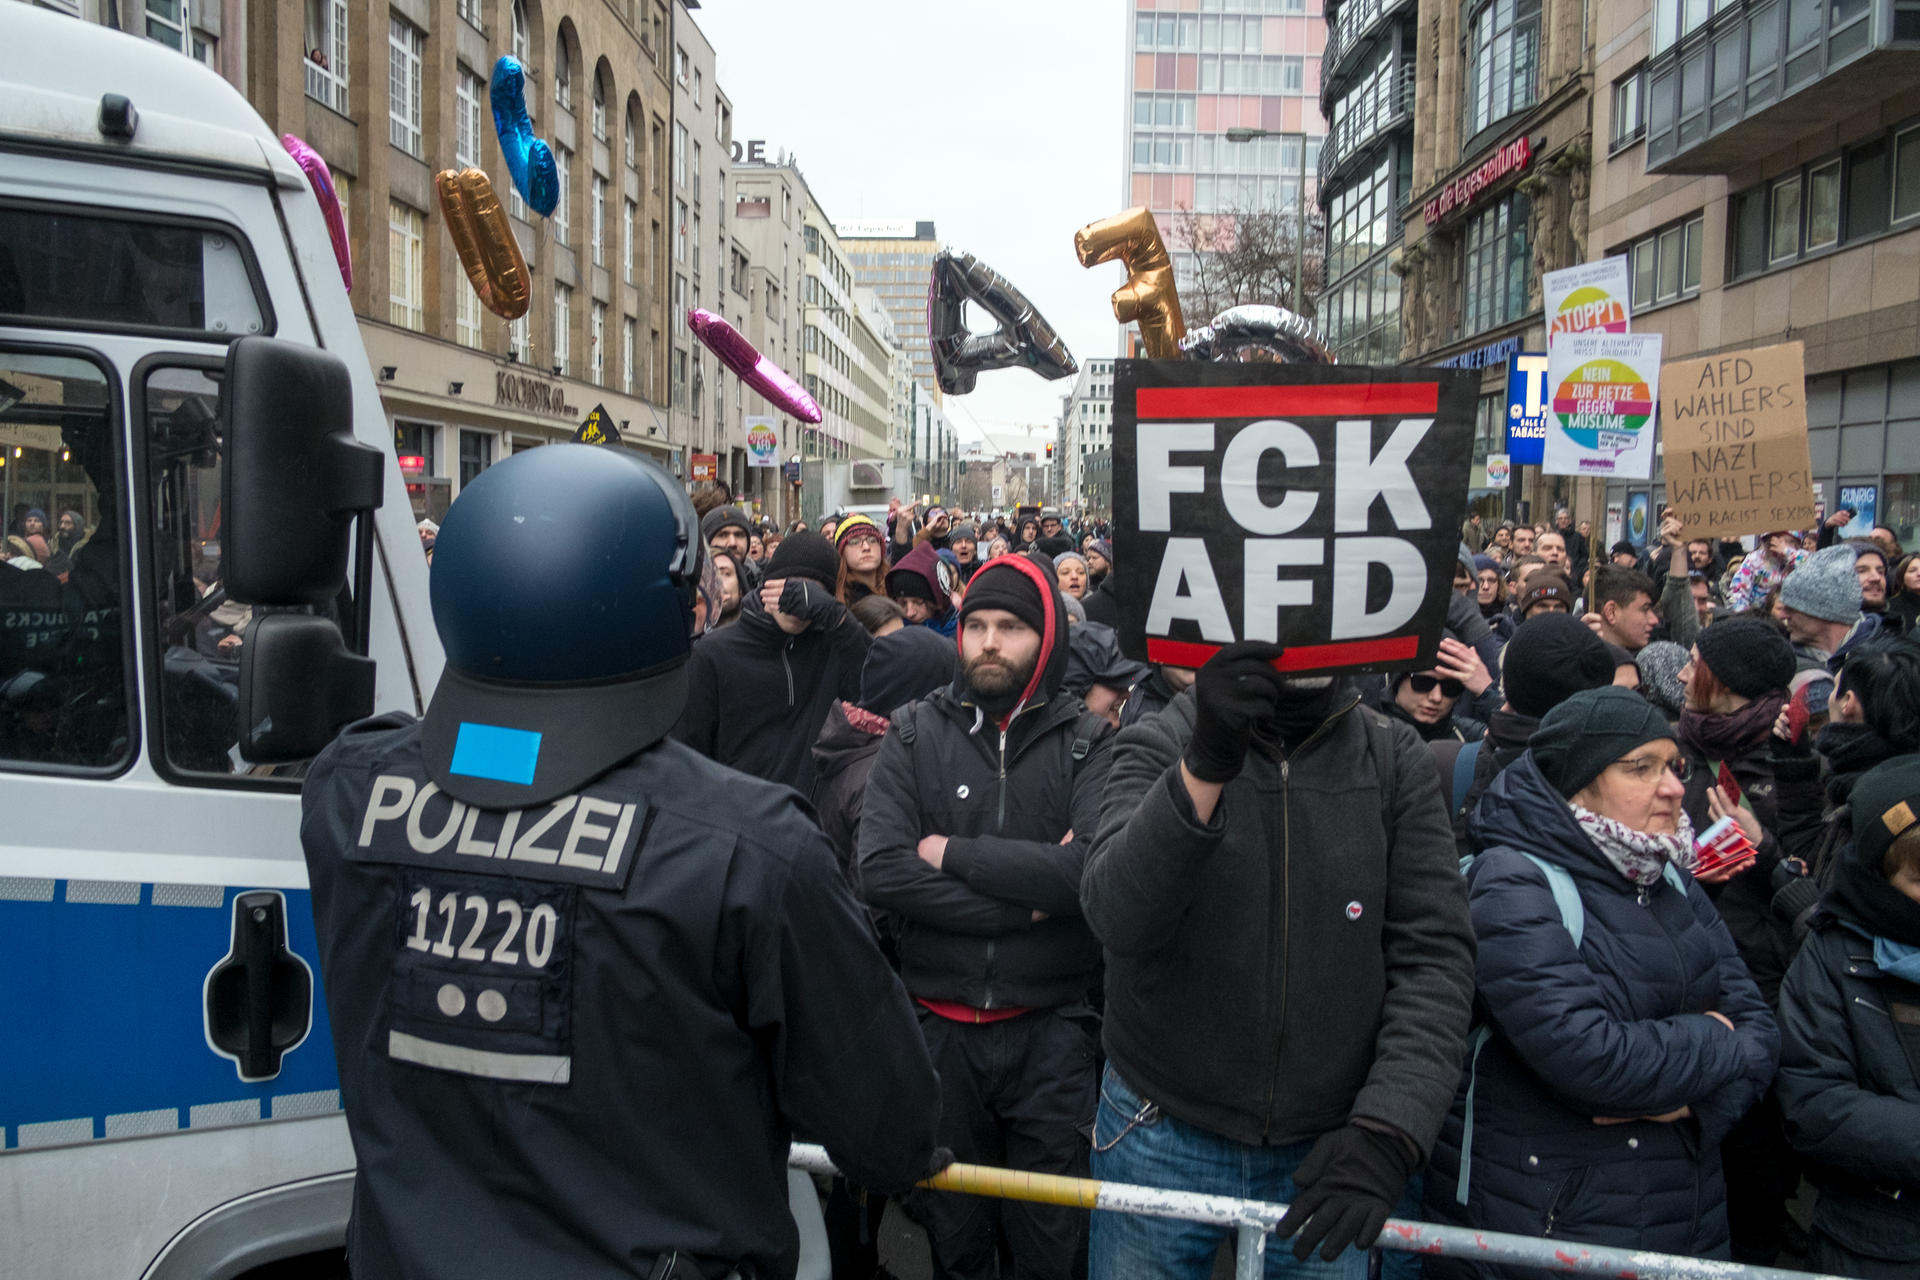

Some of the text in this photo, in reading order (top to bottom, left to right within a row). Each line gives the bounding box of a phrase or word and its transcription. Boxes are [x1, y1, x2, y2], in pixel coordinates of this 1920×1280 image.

[1439, 184, 1457, 216] die
[1553, 298, 1614, 334] STOPPT
[1517, 356, 1548, 417] T
[1582, 367, 1611, 382] NEIN
[1698, 358, 1753, 388] AFD
[1571, 384, 1633, 400] ZUR HETZE
[1520, 418, 1538, 427] SALE
[1568, 414, 1626, 429] MUSLIME
[1576, 400, 1615, 415] GEGEN
[1700, 418, 1755, 444] SIND
[1691, 443, 1757, 473] NAZI
[1136, 418, 1436, 536] FCK
[1672, 470, 1809, 504] WÄHLERS!
[1841, 487, 1876, 504] RUNRIG
[1709, 509, 1760, 526] RACIST
[1145, 536, 1428, 643] AFD
[358, 775, 637, 874] POLIZEI
[406, 887, 557, 968] 11220
